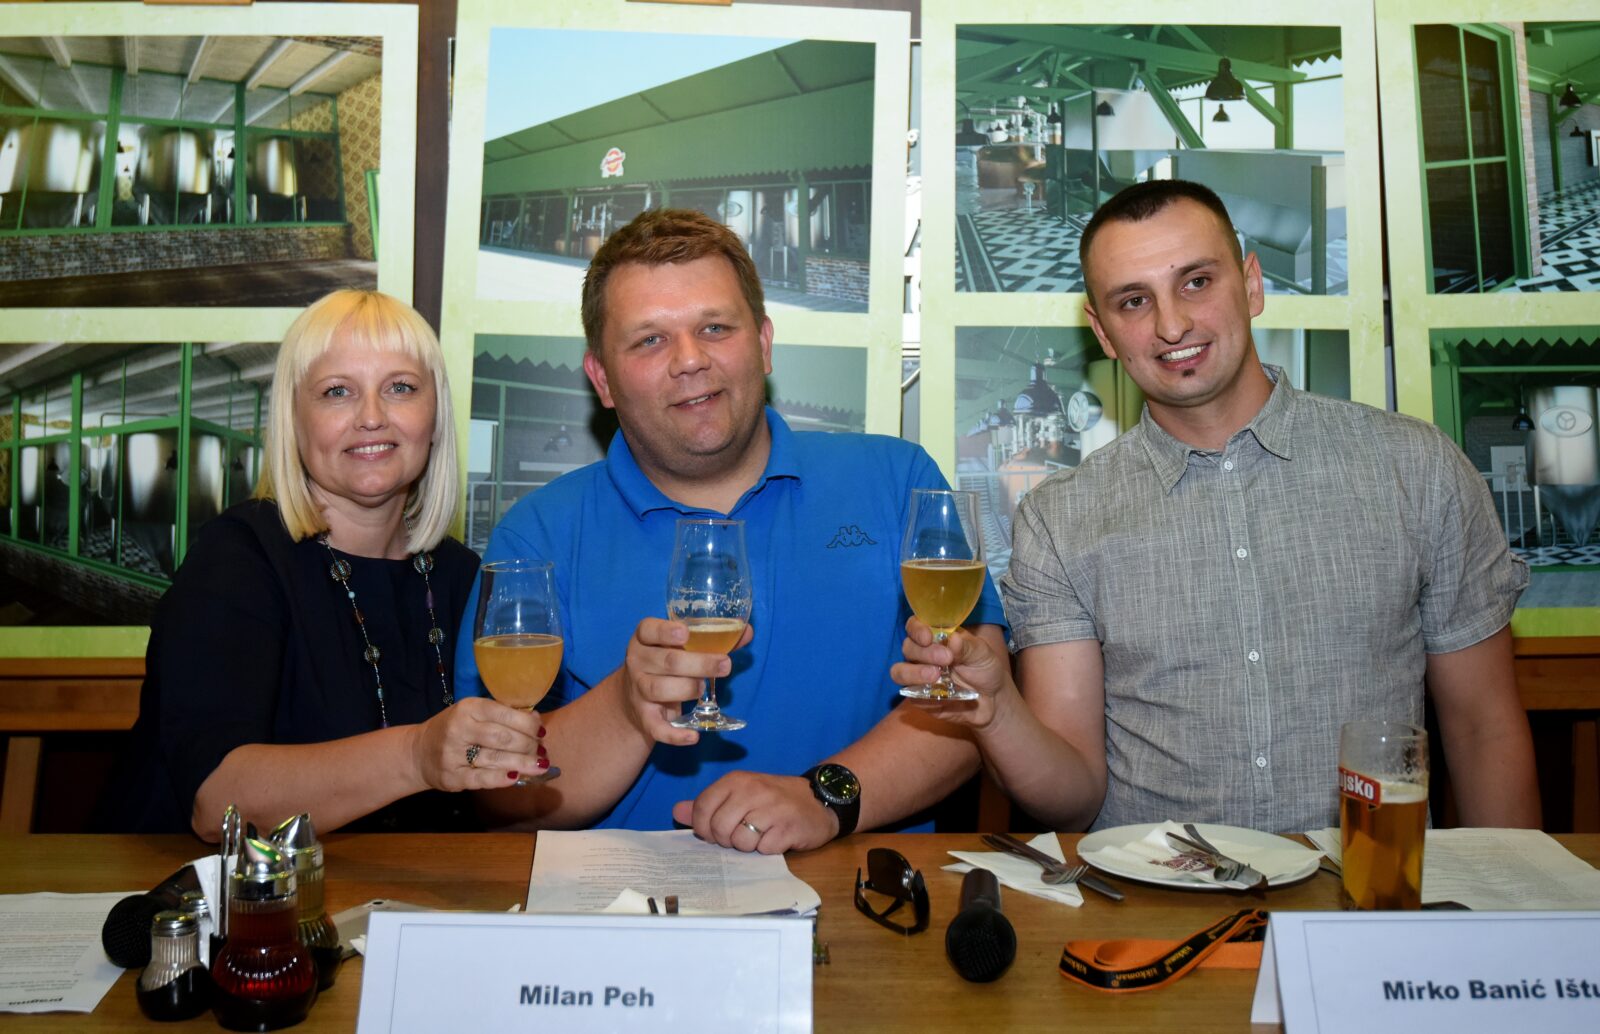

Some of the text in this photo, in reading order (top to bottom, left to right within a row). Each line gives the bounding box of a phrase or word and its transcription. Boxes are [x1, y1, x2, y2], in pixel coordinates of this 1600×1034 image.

[1115, 967, 1158, 980] kikkoman
[519, 985, 655, 1007] Milan Peh
[1383, 980, 1460, 1001] Mirko
[1468, 978, 1547, 1000] Banić
